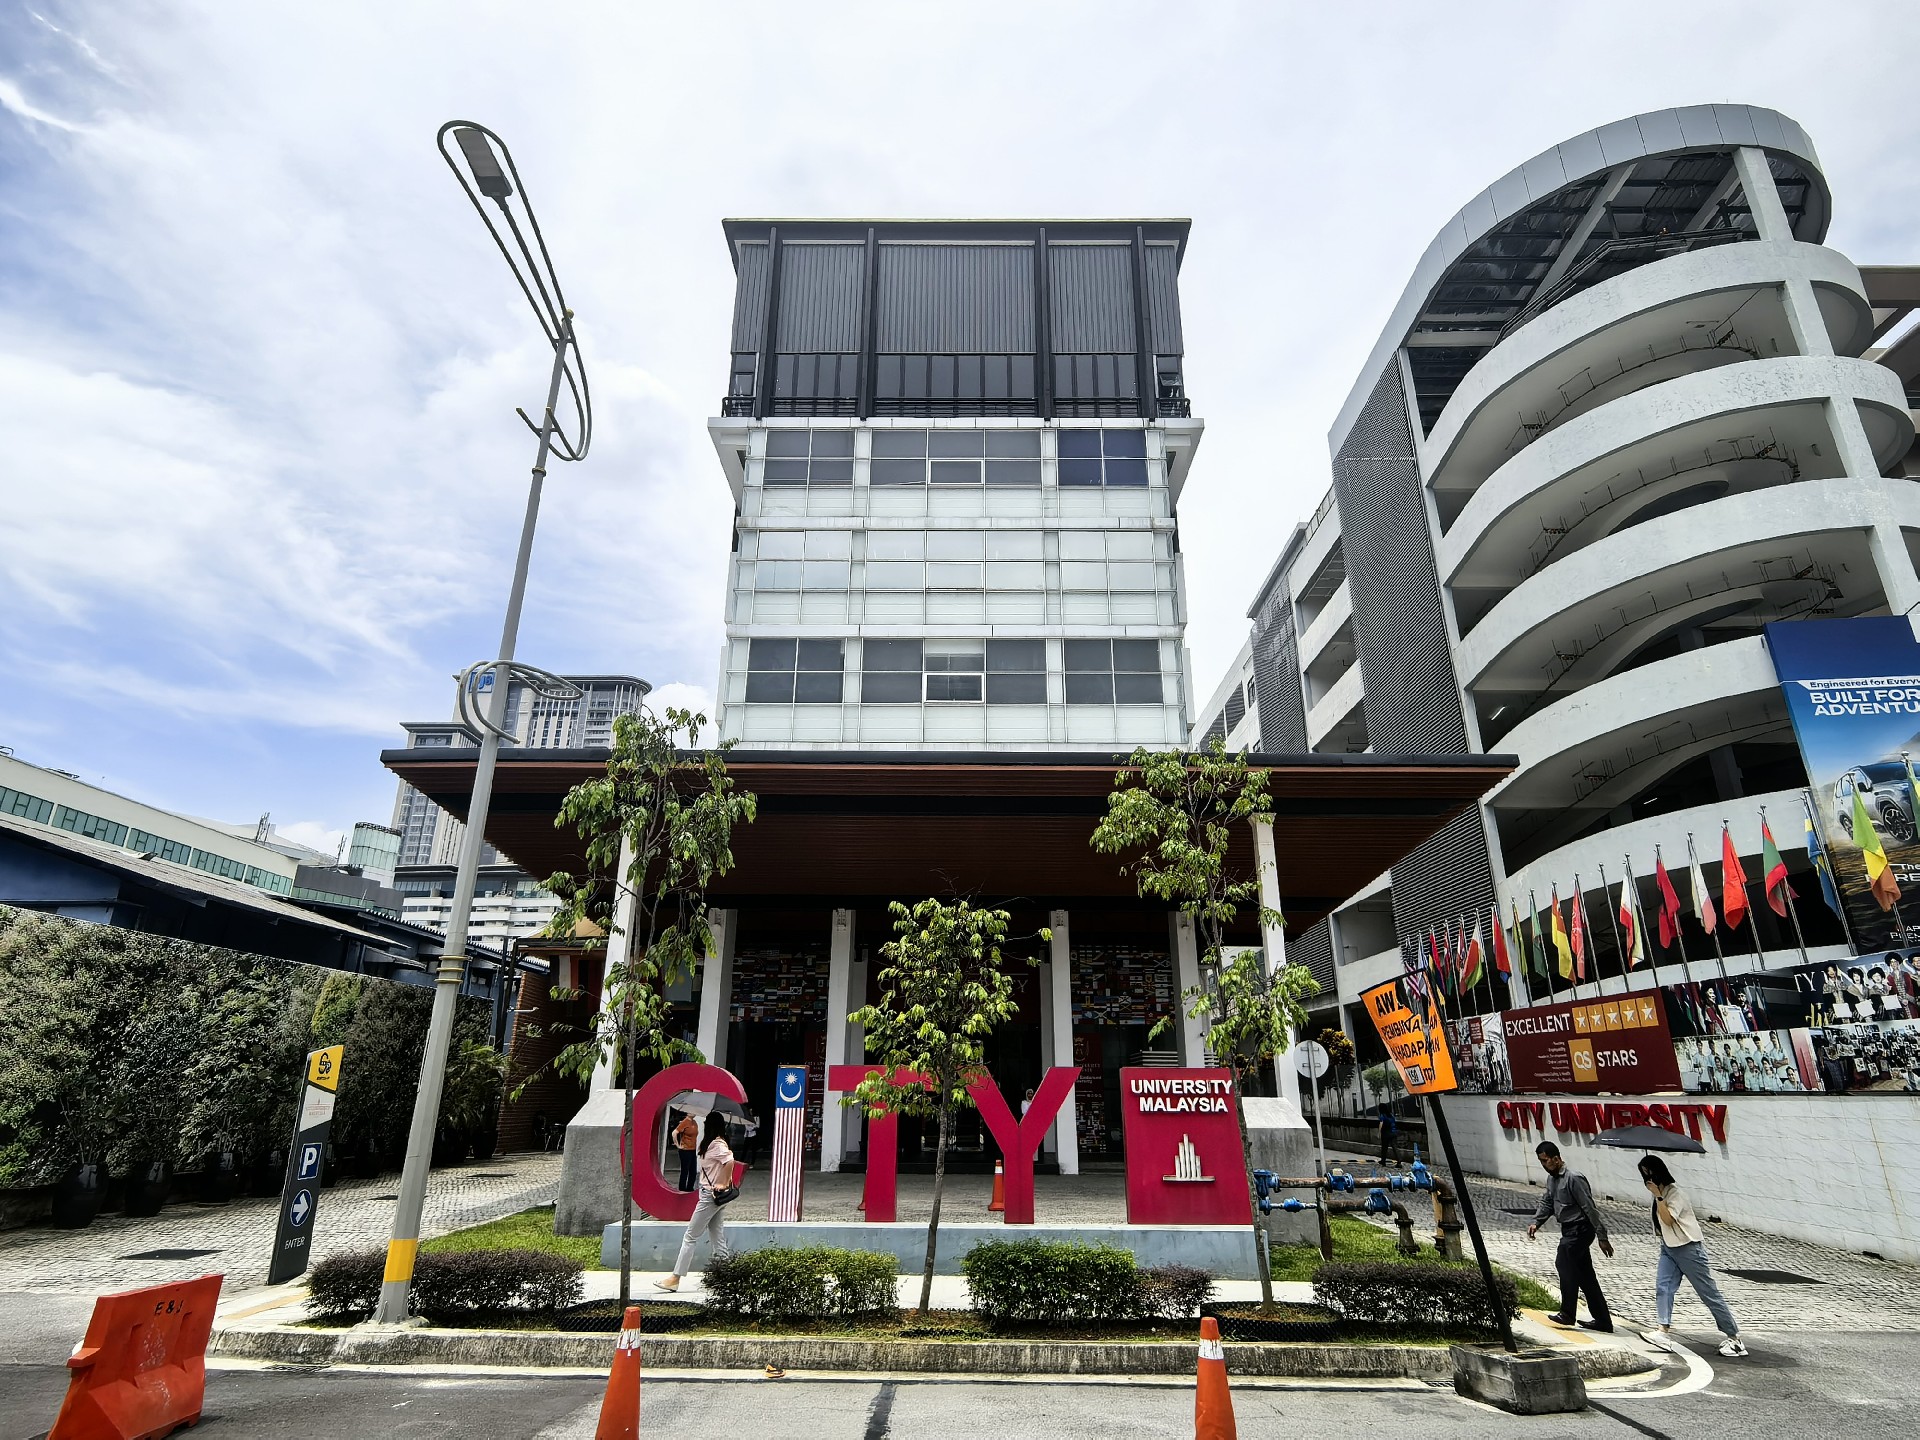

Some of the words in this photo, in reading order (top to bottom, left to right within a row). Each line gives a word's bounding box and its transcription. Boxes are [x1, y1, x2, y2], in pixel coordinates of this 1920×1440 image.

[1809, 679, 1869, 689] Engineered
[1870, 679, 1885, 687] for
[1809, 690, 1871, 704] BUILT
[1873, 688, 1920, 702] FOR
[1814, 701, 1920, 716] ADVENTU
[1505, 1013, 1570, 1037] EXCELLENT
[1573, 1050, 1593, 1071] QS
[1596, 1049, 1638, 1068] STARS
[1130, 1079, 1233, 1095] UNIVERSITY
[1140, 1096, 1228, 1113] MALAYSIA
[1496, 1101, 1545, 1132] CITY
[1548, 1102, 1727, 1143] UNIVERSITY
[301, 1147, 317, 1176] P
[284, 1236, 306, 1250] ENTER
